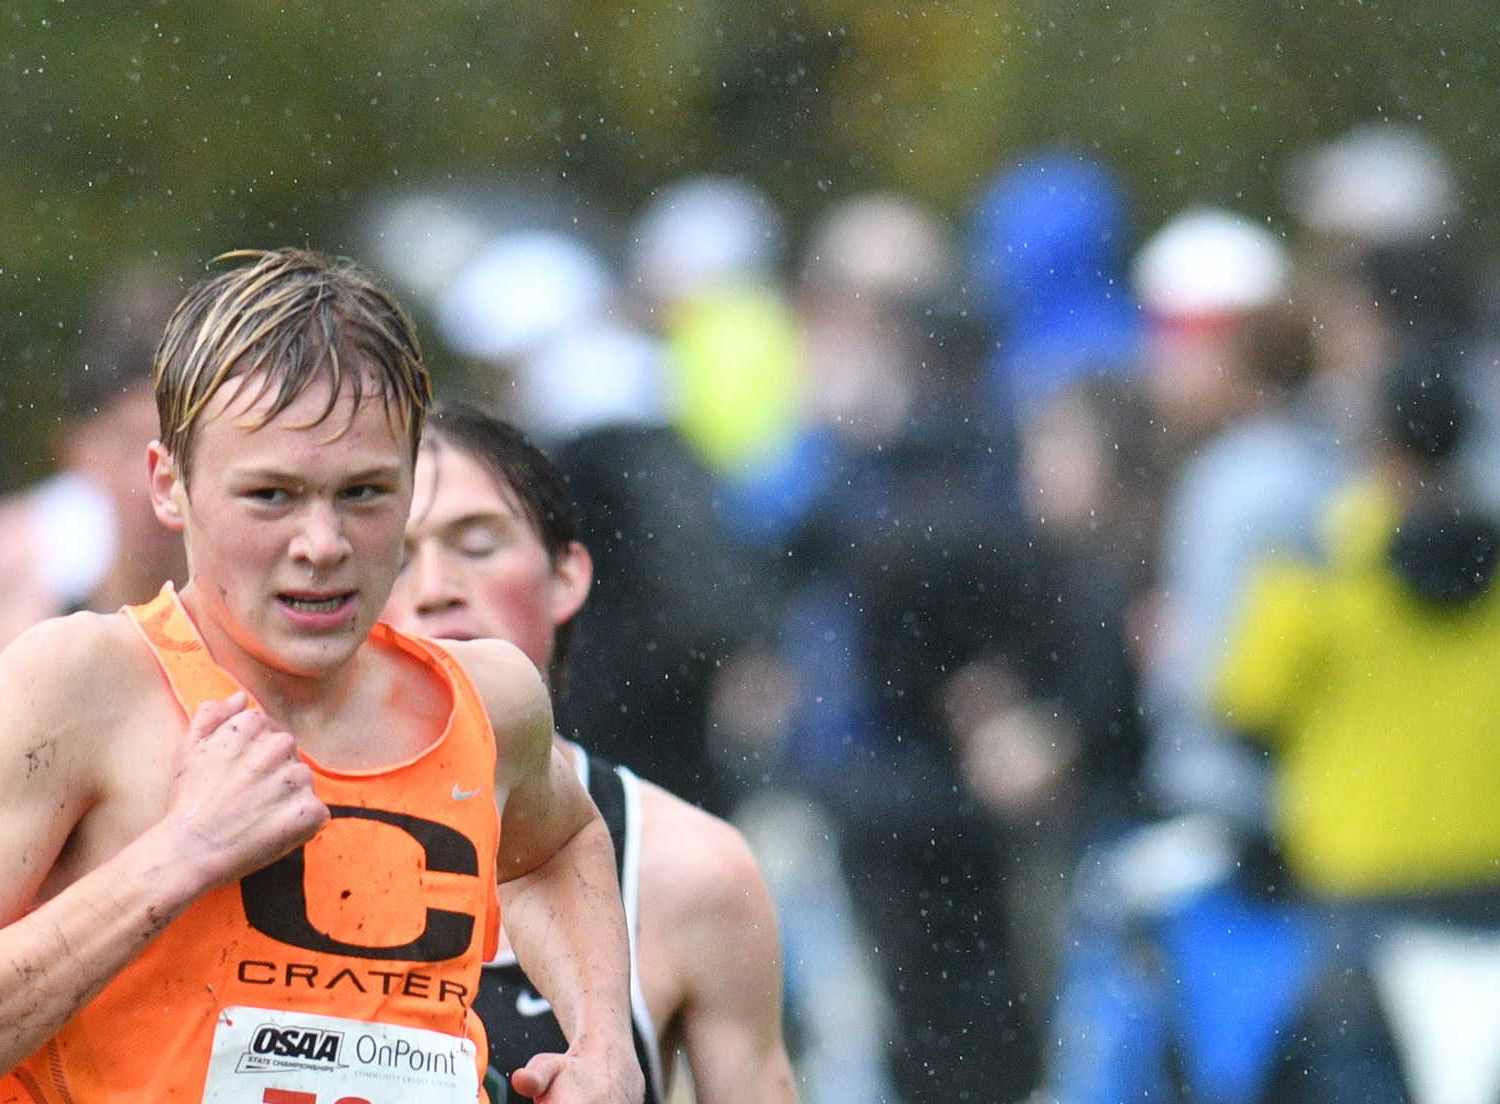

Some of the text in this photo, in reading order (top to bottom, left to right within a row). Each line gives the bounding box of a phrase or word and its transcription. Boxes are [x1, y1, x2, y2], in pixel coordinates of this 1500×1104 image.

[240, 804, 479, 962] C
[238, 960, 469, 1008] CRATER
[253, 1027, 340, 1062] OSAA
[356, 1034, 456, 1076] OnPoint
[248, 1056, 334, 1072] STATE CHAMPIONSHIPS
[355, 1070, 457, 1089] COMMUNITY CREDIT UNION
